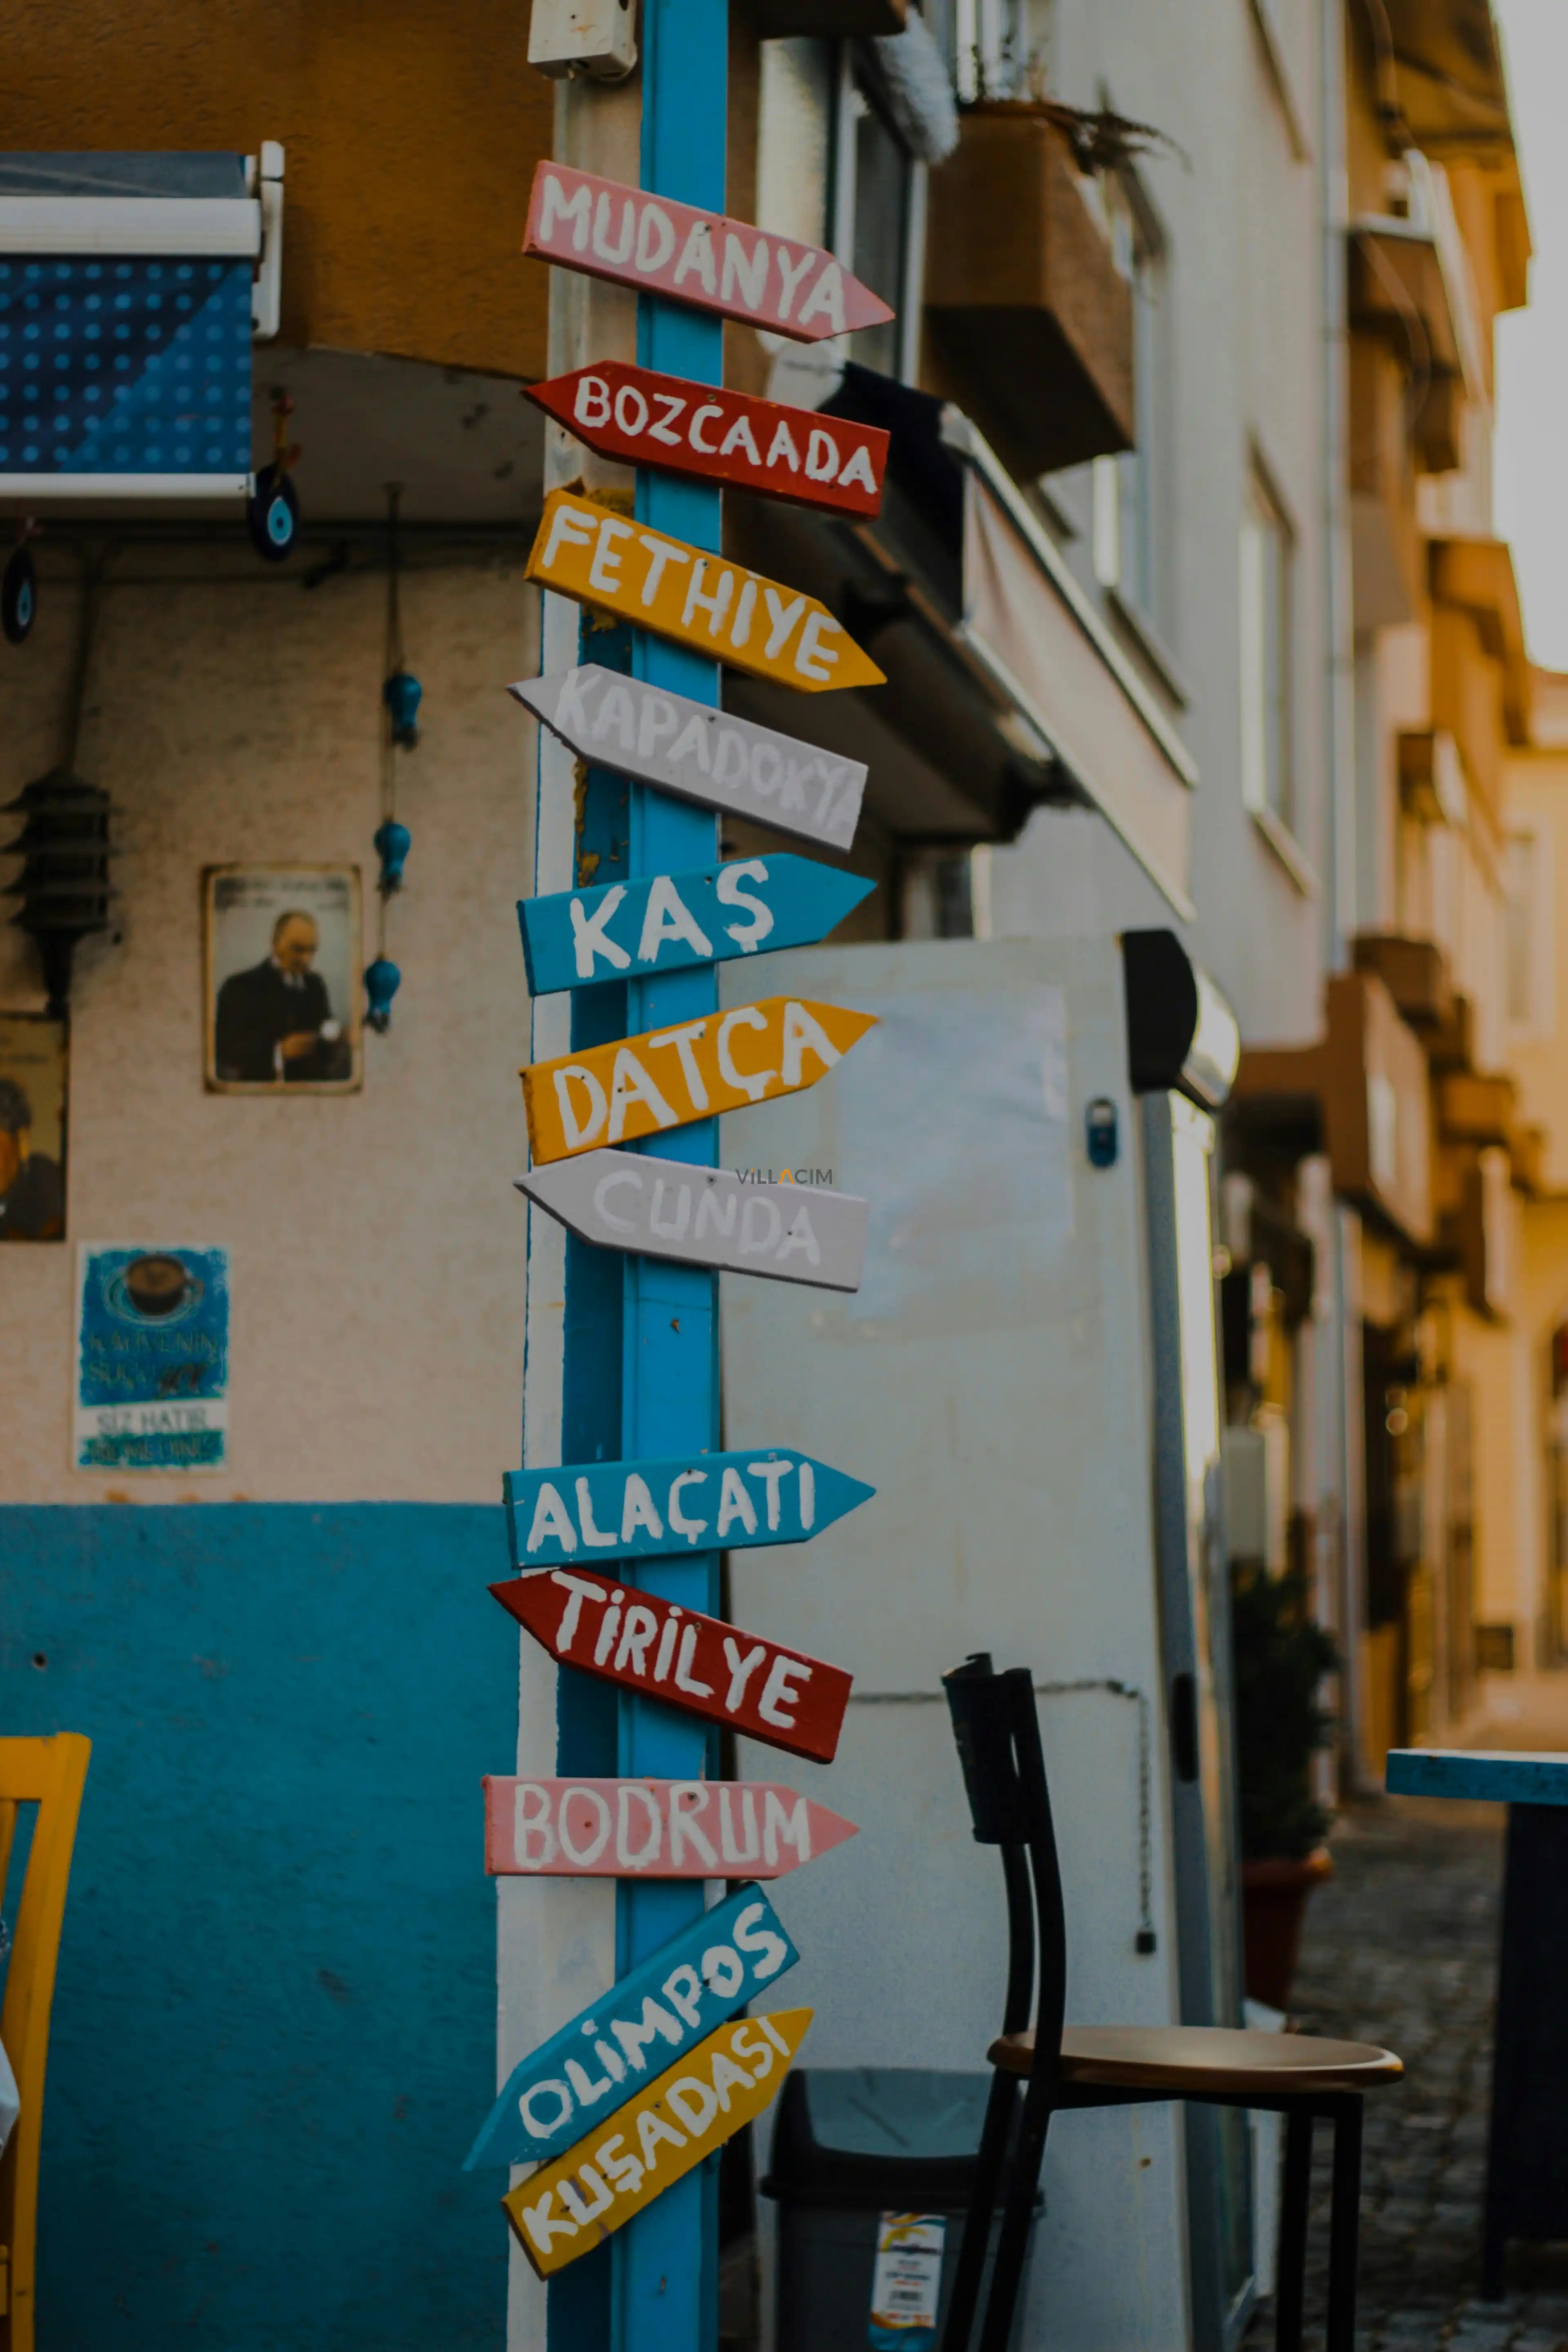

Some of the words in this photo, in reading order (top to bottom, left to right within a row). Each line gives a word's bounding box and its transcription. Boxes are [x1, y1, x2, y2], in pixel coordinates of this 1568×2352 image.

[540, 175, 846, 333] MUDANYA
[573, 376, 877, 494] BOZCAADA
[570, 859, 773, 978] KAŞ
[554, 1002, 841, 1150] DATÇA
[594, 1169, 820, 1265] CUNDA
[526, 1460, 815, 1553] ALAÇATI
[551, 1570, 812, 1729] TİRİLYE
[513, 1783, 811, 1870] BODRUM
[518, 1902, 788, 2139] OLİMPOS
[522, 2016, 790, 2254] KUŞADASI
